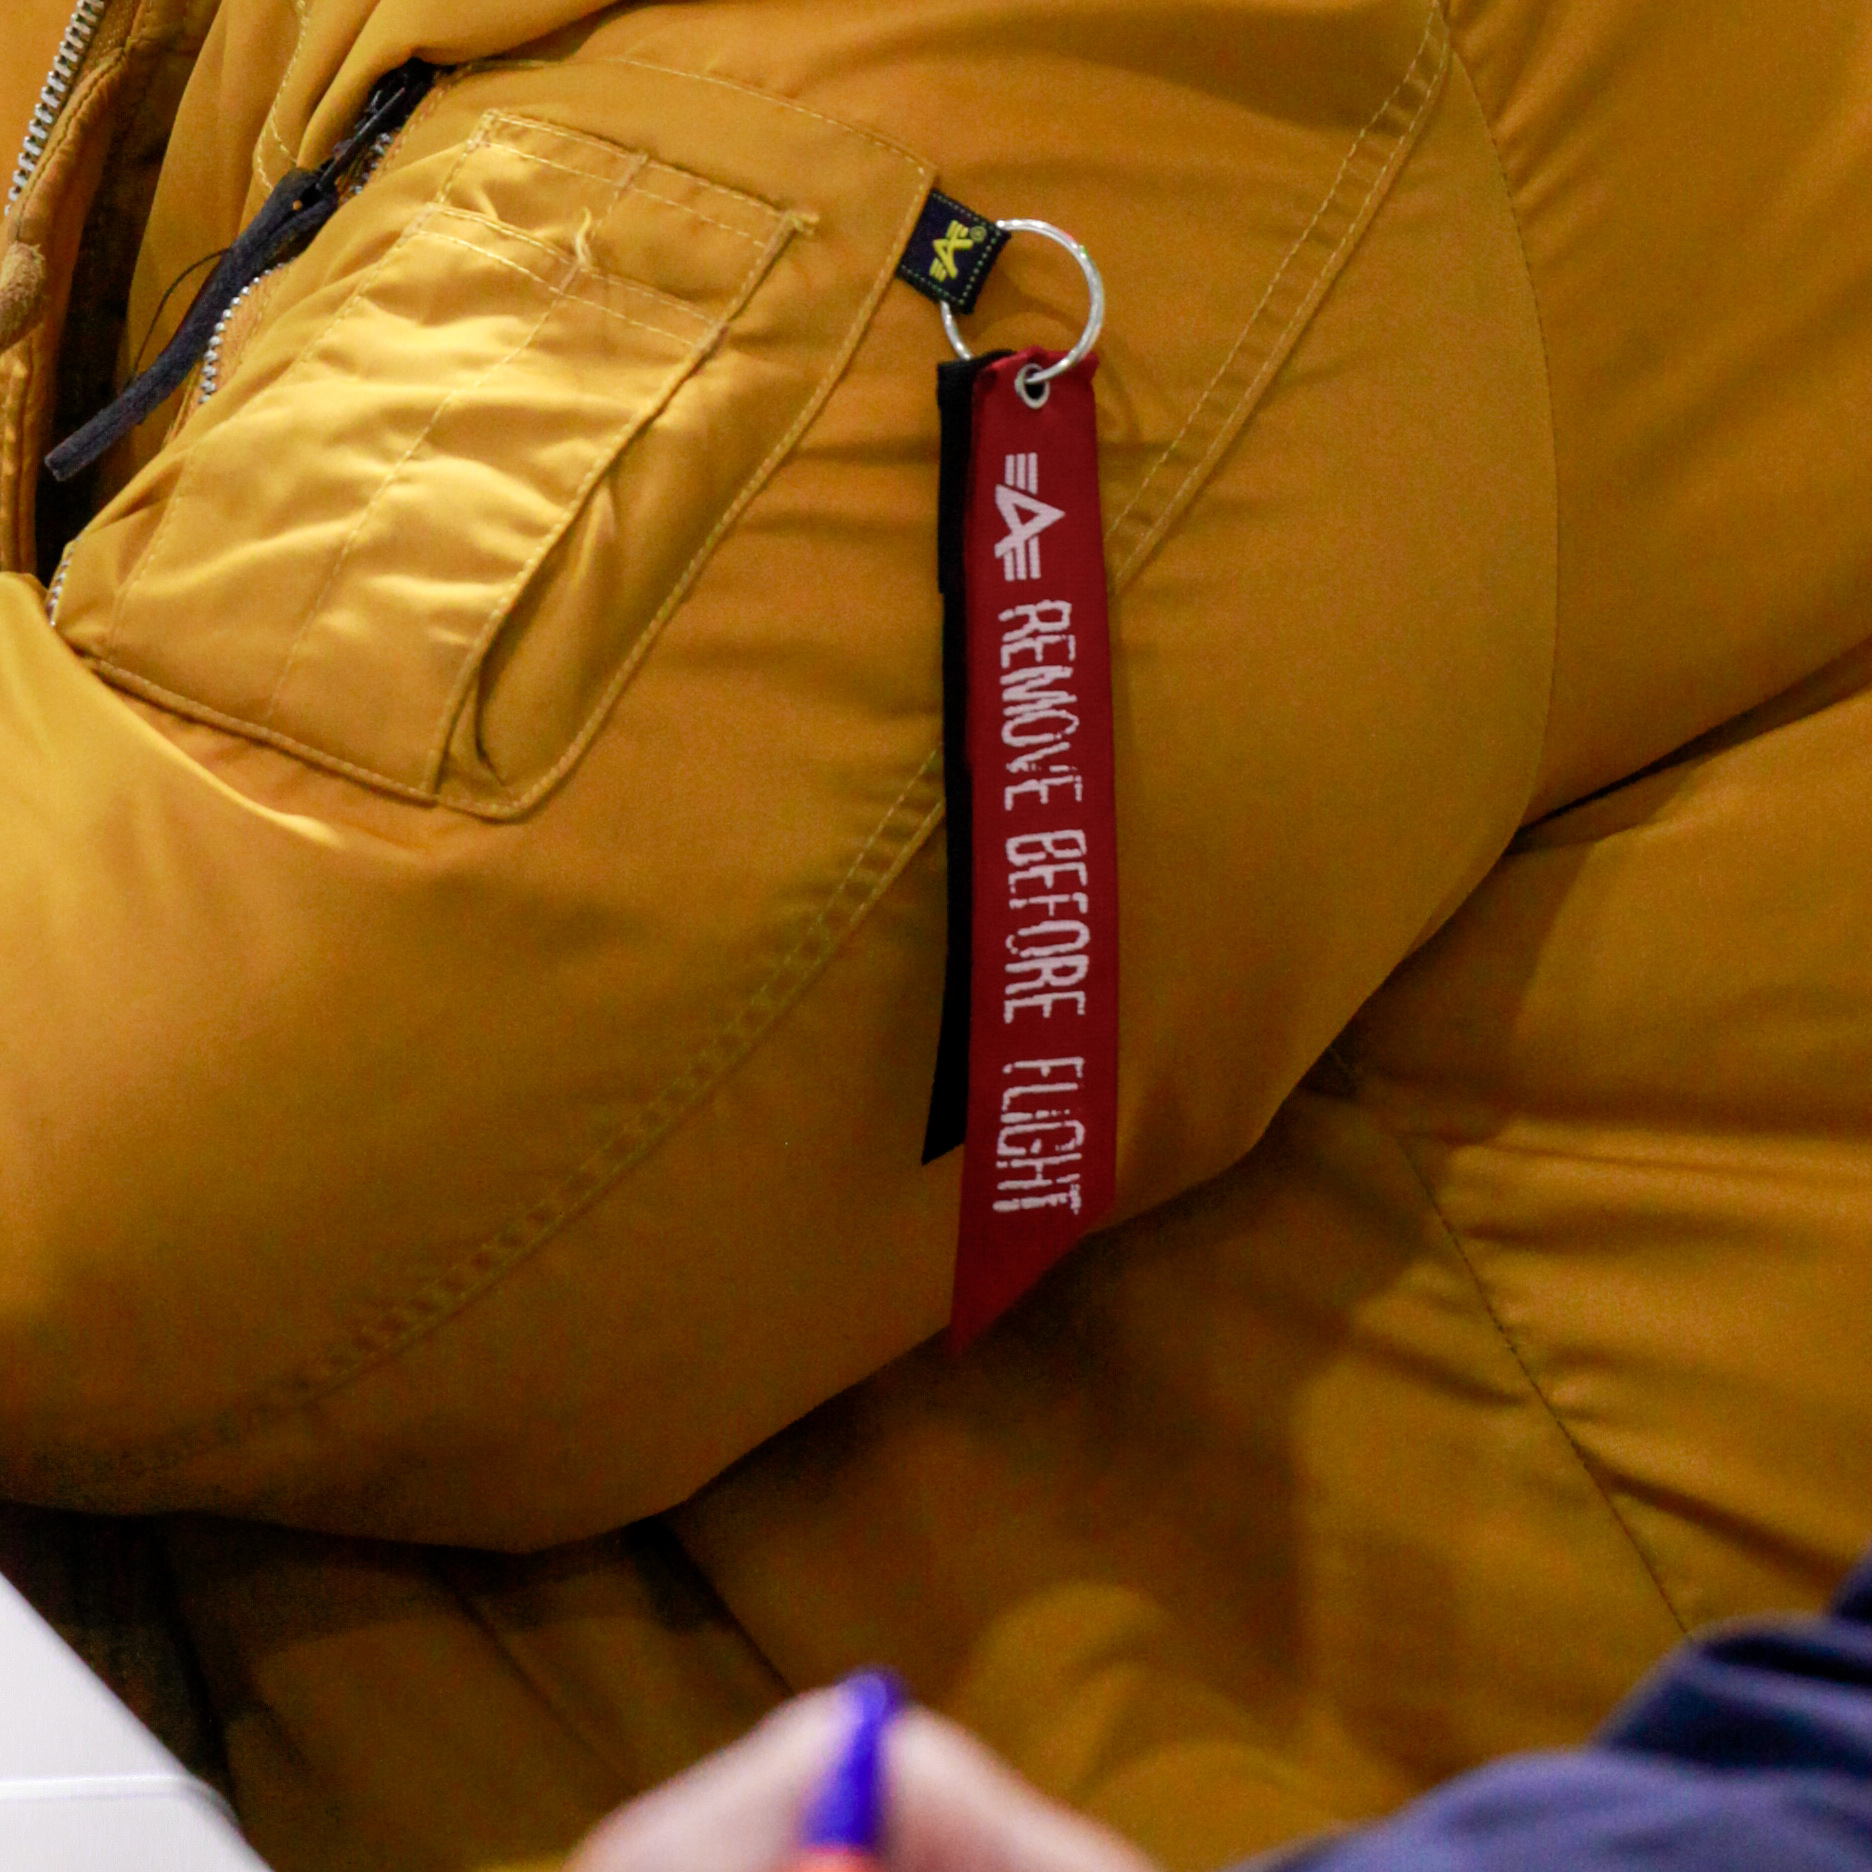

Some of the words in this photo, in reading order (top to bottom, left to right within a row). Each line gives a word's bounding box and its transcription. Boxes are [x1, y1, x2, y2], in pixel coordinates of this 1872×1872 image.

[998, 599, 1083, 811] REMOVE
[1003, 828, 1089, 1024] BEFORE
[992, 1055, 1085, 1215] FLIGHT
